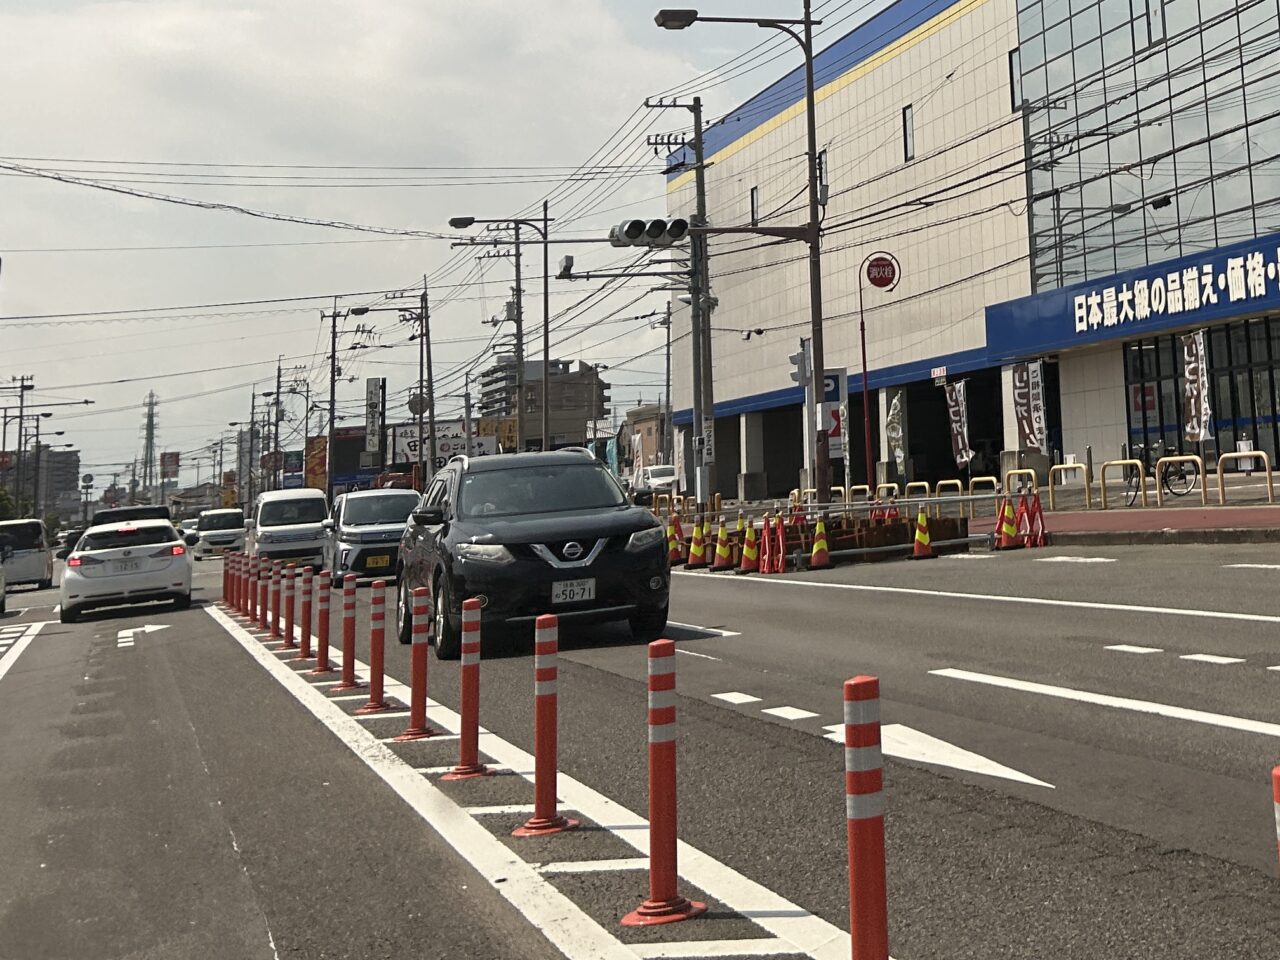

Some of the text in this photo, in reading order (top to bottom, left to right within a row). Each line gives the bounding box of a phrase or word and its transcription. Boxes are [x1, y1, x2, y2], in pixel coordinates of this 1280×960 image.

[869, 266, 894, 279] 消火栓
[561, 587, 591, 600] 50-71
